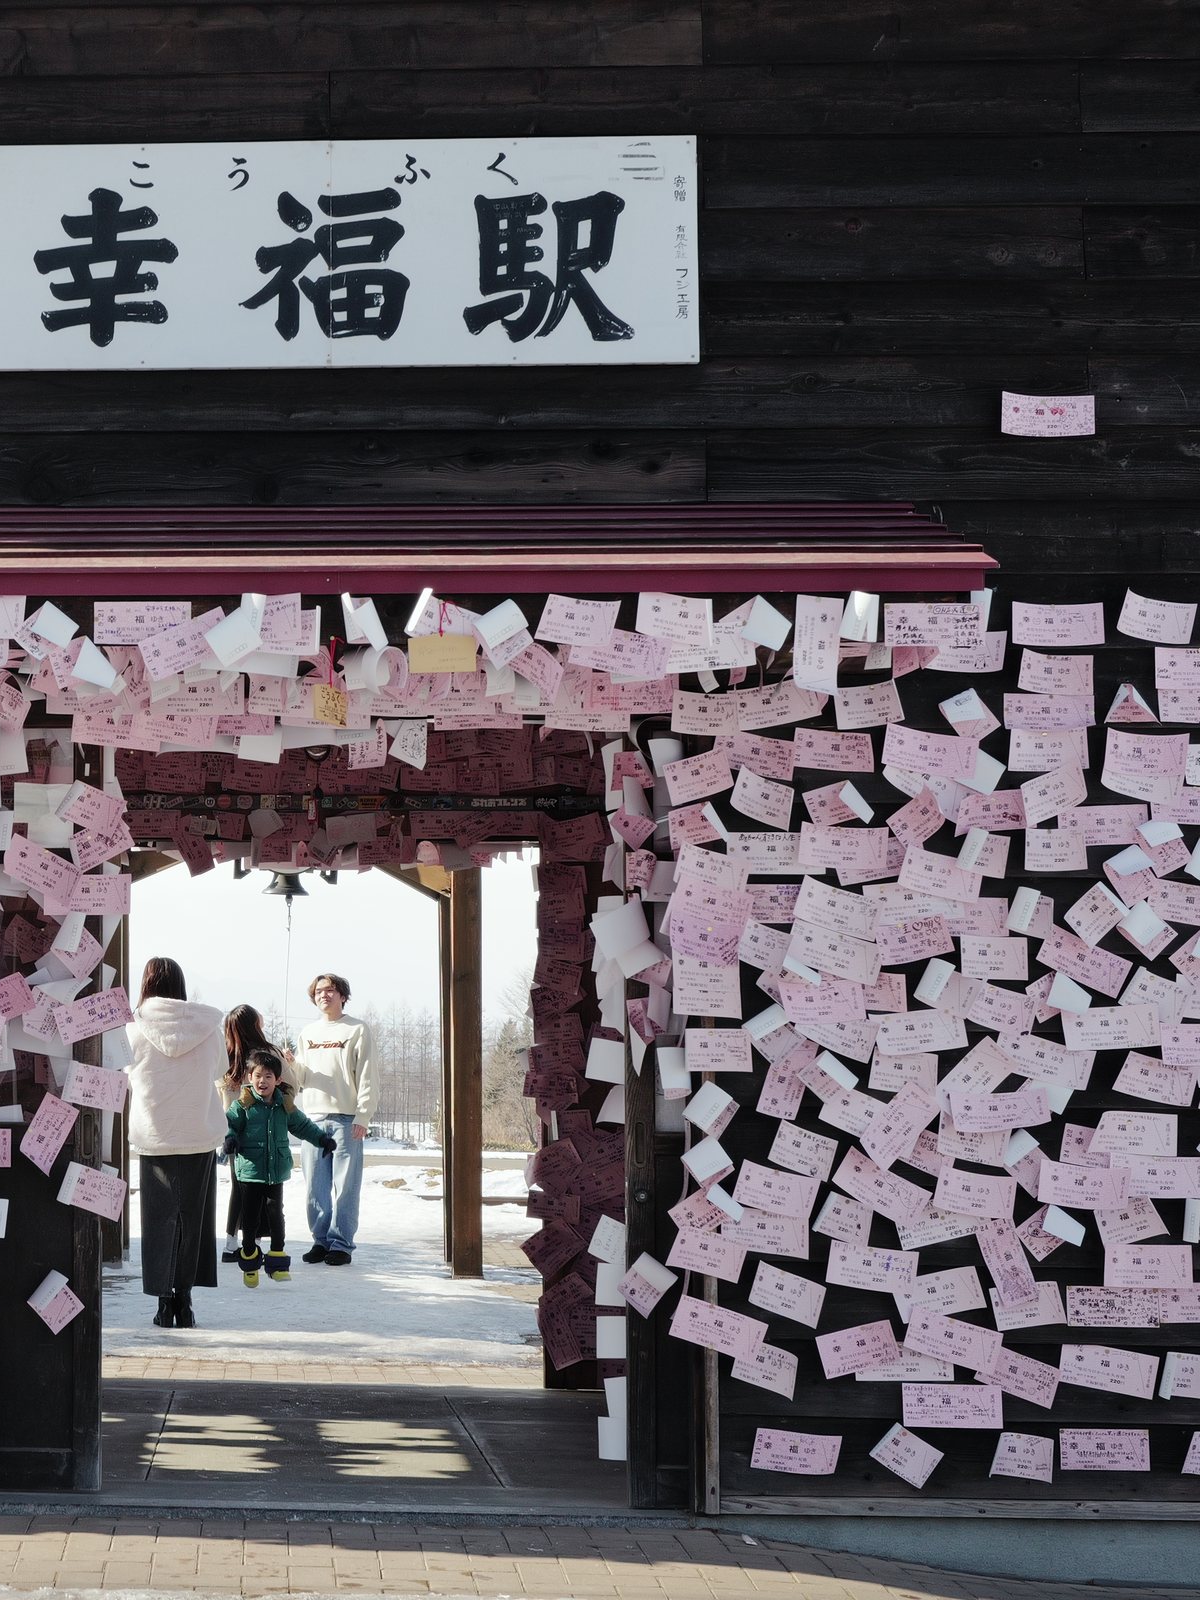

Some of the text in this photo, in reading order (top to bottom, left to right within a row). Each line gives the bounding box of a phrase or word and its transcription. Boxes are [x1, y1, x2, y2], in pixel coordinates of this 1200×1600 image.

[34, 188, 635, 347] 幸福駅
[565, 612, 575, 620] 福
[1044, 667, 1052, 675] 福
[1096, 818, 1105, 826] 福
[1074, 1178, 1085, 1186] 福
[714, 1320, 723, 1328] 福
[944, 1331, 953, 1339] 福
[941, 1397, 951, 1405] 福
[789, 1445, 798, 1454] 福
